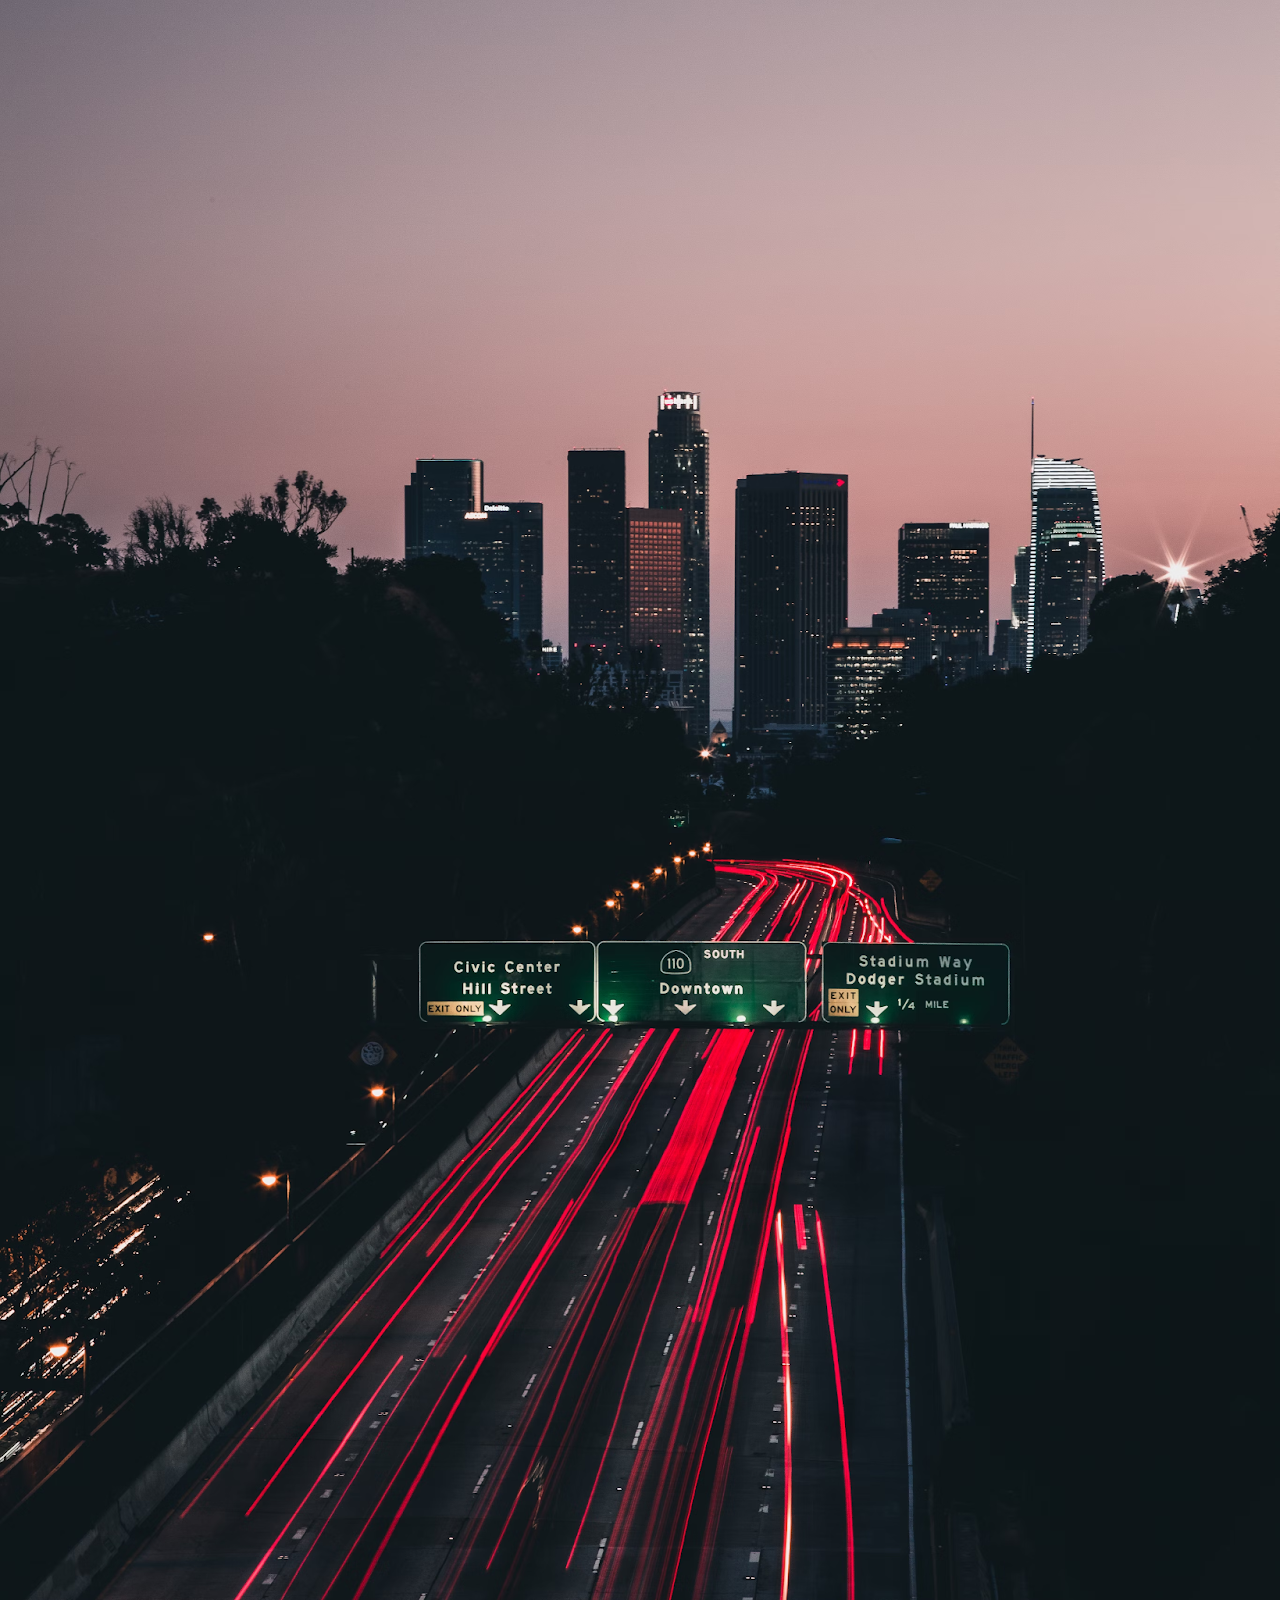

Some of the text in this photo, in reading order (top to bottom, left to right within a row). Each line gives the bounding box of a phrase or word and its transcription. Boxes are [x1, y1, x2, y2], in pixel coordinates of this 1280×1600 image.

[704, 950, 745, 960] SOUTH
[453, 961, 561, 974] Civic Center
[667, 957, 685, 970] 110
[859, 955, 973, 972] Stadium Way
[846, 973, 985, 989] Dodger Stadium
[462, 982, 553, 995] Hill Street
[659, 982, 744, 995] Downtown
[830, 991, 857, 1000] EXIT
[428, 1004, 482, 1014] EXIT ONLY
[830, 1005, 857, 1014] ONLY
[925, 1000, 950, 1009] MILE
[994, 1053, 1024, 1061] TRAFFIC
